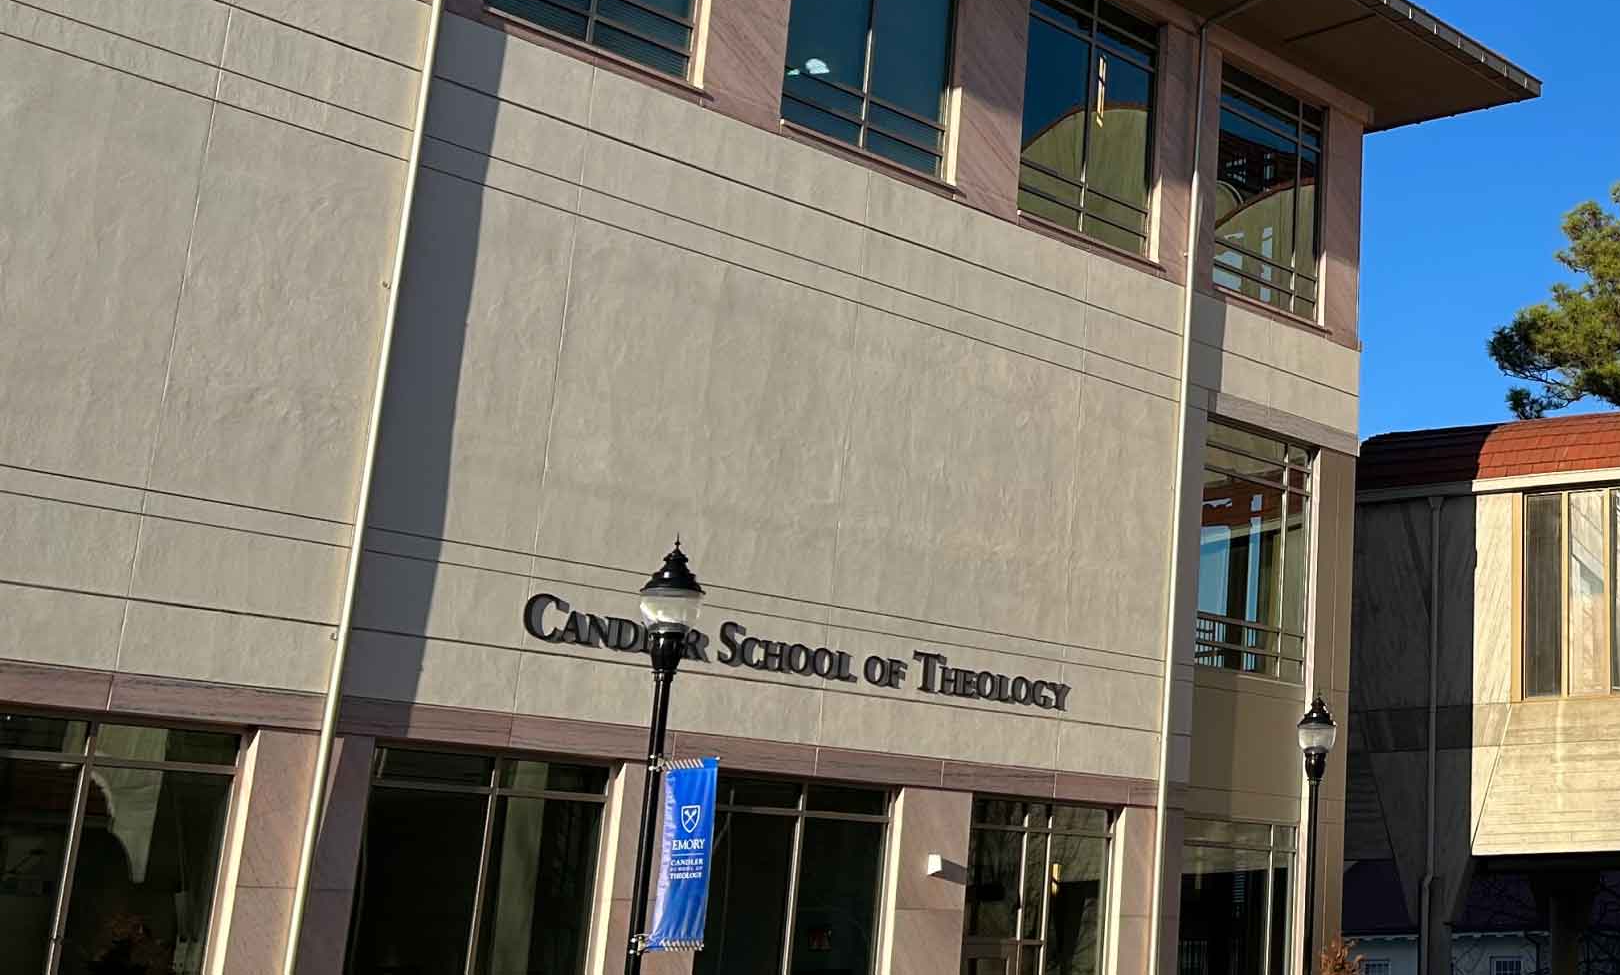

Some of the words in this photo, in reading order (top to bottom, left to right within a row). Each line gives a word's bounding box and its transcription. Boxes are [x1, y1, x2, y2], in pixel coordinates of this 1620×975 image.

[717, 621, 858, 684] SCHOOL
[863, 645, 908, 690] OF
[913, 650, 1072, 712] THEOLOGY
[672, 838, 705, 850] EMORY
[670, 858, 704, 866] CANDLER
